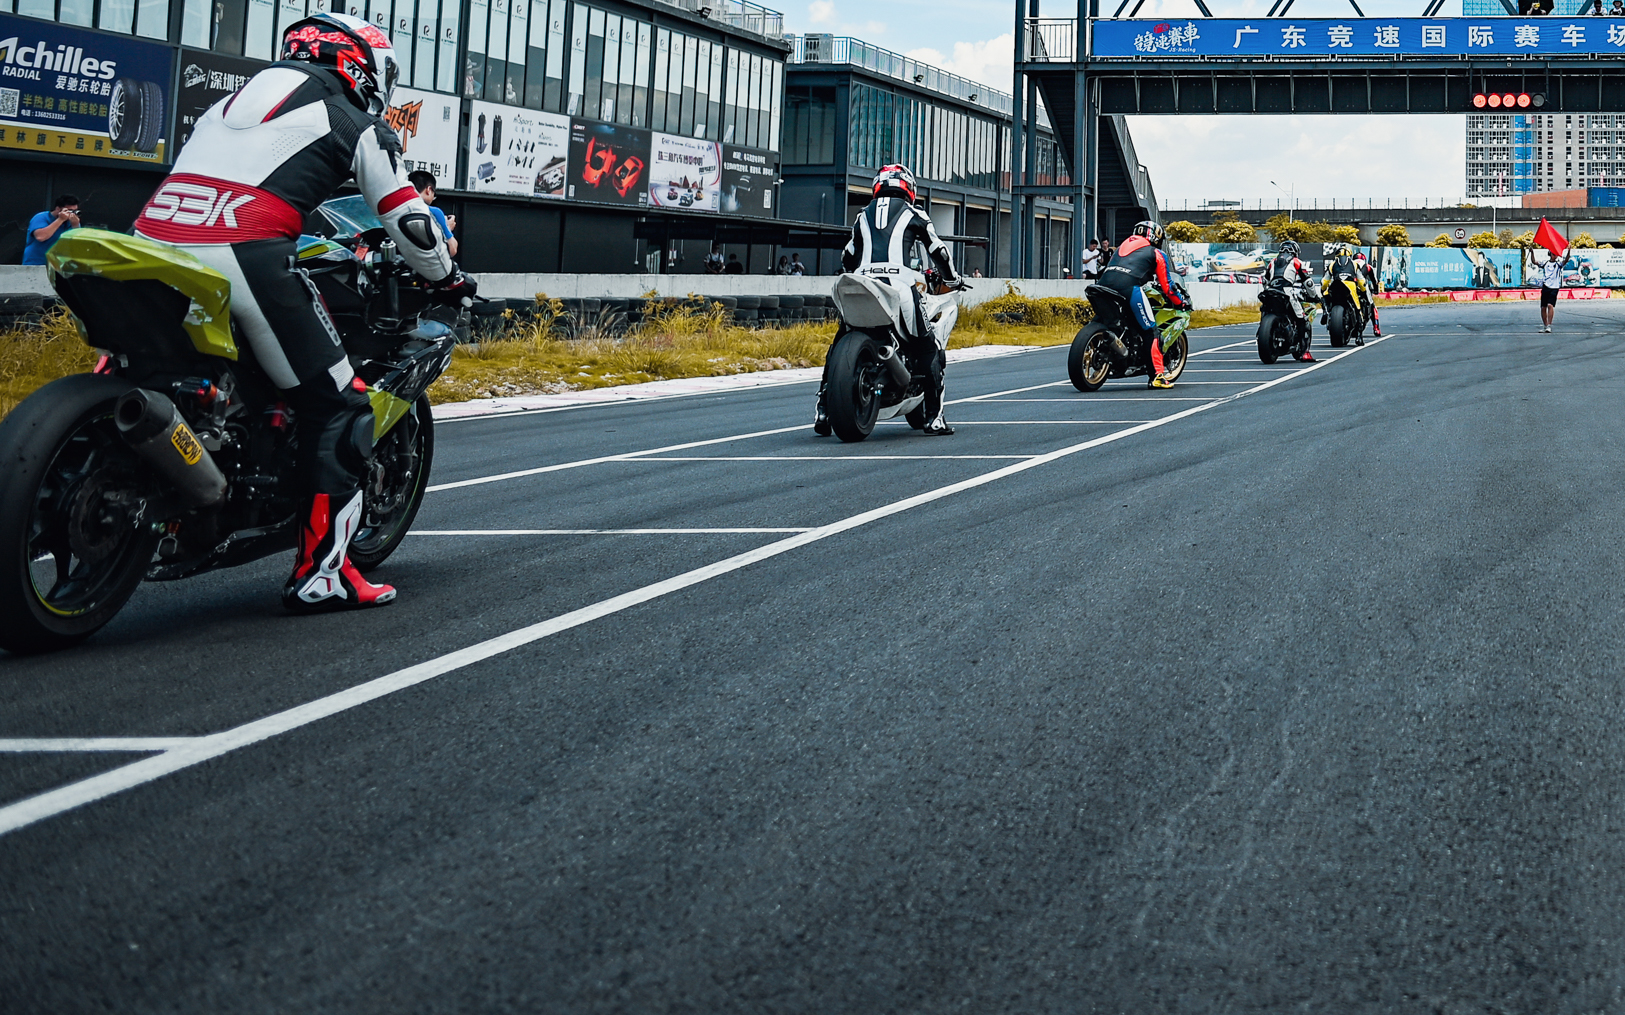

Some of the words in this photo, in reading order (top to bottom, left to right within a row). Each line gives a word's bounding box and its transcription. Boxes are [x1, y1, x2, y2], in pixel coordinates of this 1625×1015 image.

[0, 37, 117, 80] Achilles
[2, 65, 42, 81] RADIAL
[346, 62, 374, 88] KYT
[55, 75, 112, 97] 爱驰乐轮胎
[58, 98, 108, 117] 高性能轮胎
[145, 182, 256, 228] SBK
